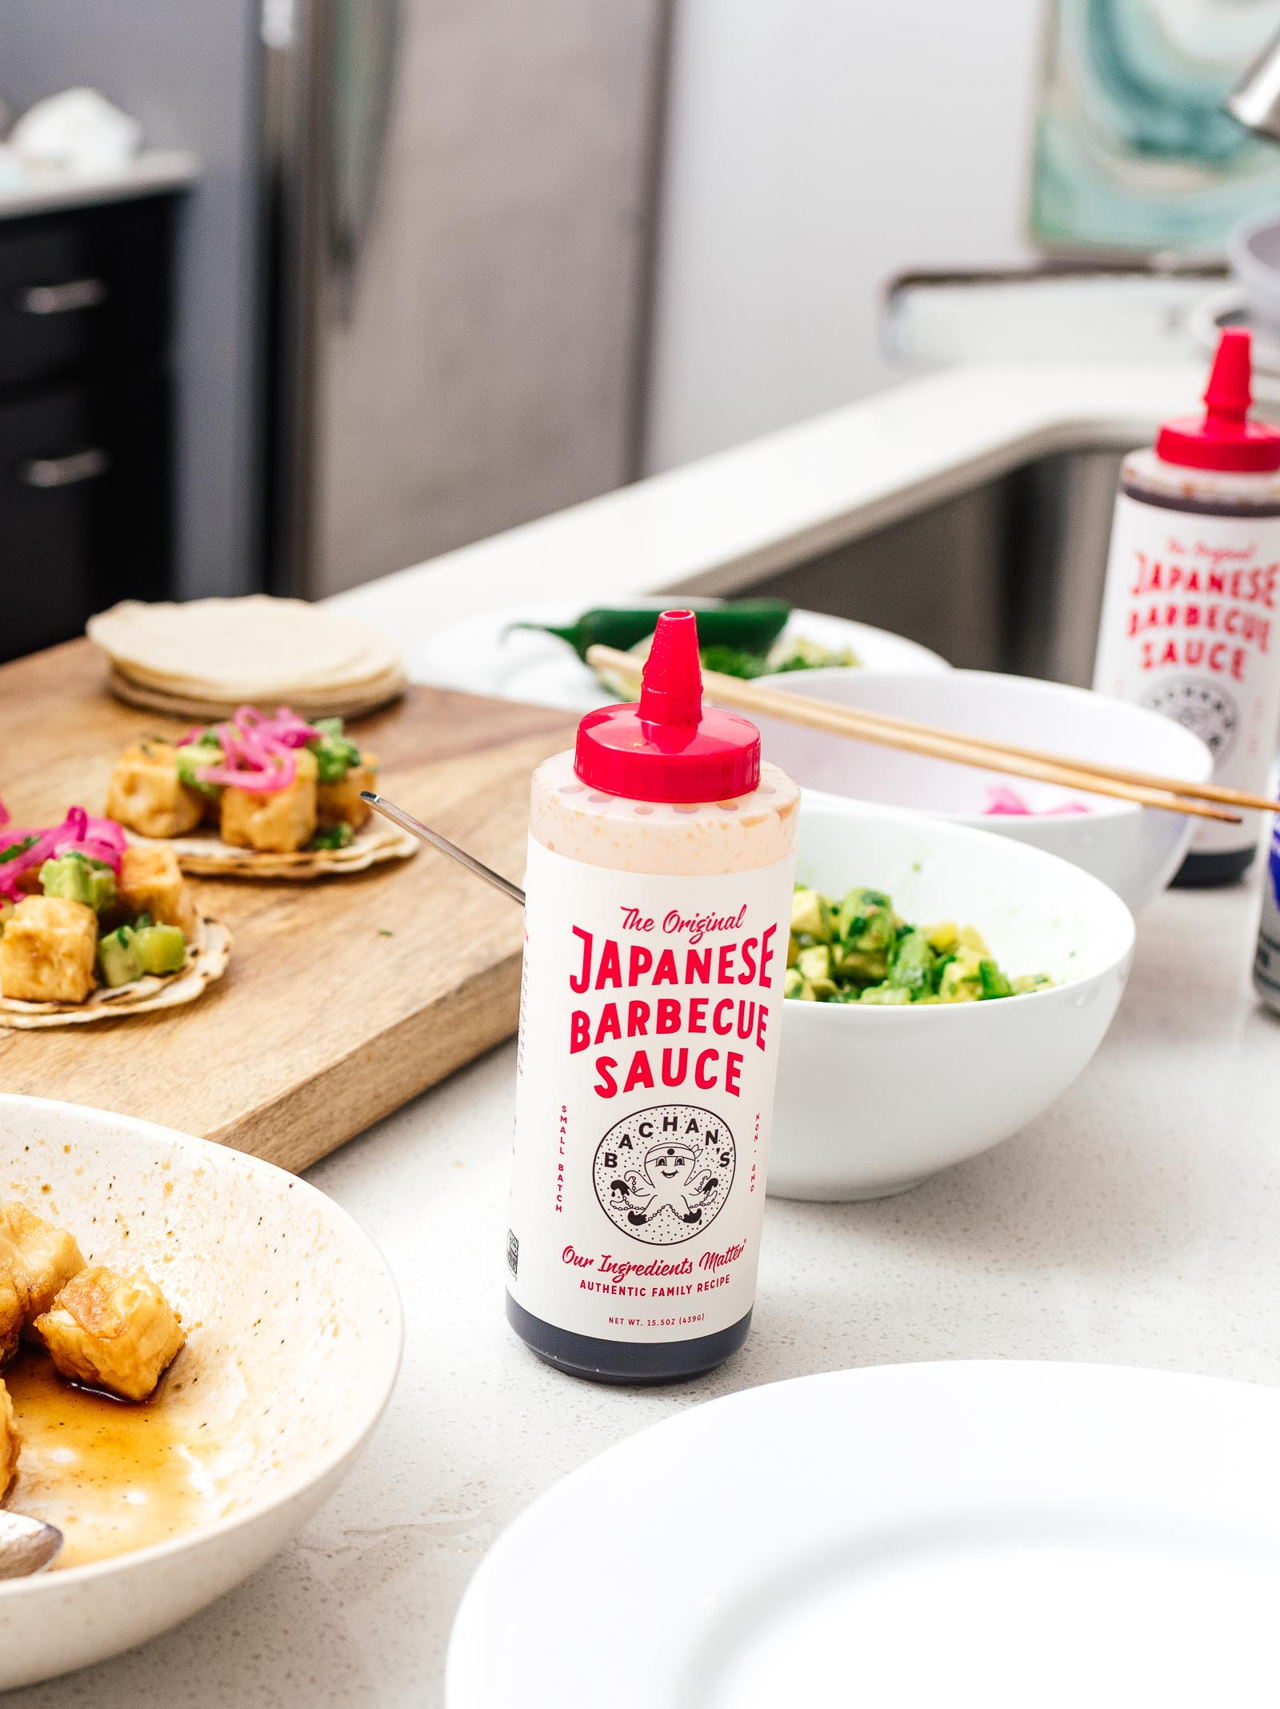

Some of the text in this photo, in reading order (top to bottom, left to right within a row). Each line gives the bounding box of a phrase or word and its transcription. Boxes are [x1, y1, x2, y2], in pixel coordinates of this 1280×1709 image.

[1131, 551, 1279, 609] JAPANESE
[620, 904, 747, 945] The Original
[570, 922, 777, 994] JAPANESE
[570, 998, 768, 1055] BARBECUE
[594, 1048, 744, 1099] SAUCE
[559, 1105, 568, 1155] SMALL
[604, 1116, 730, 1168] BACHAN'S
[555, 1163, 564, 1213] BATCH
[562, 1245, 594, 1268] Our
[597, 1254, 693, 1283] Ingredients
[579, 1274, 731, 1297] AUTHENTIC FAMILY RECIPE
[608, 1317, 624, 1325] NET
